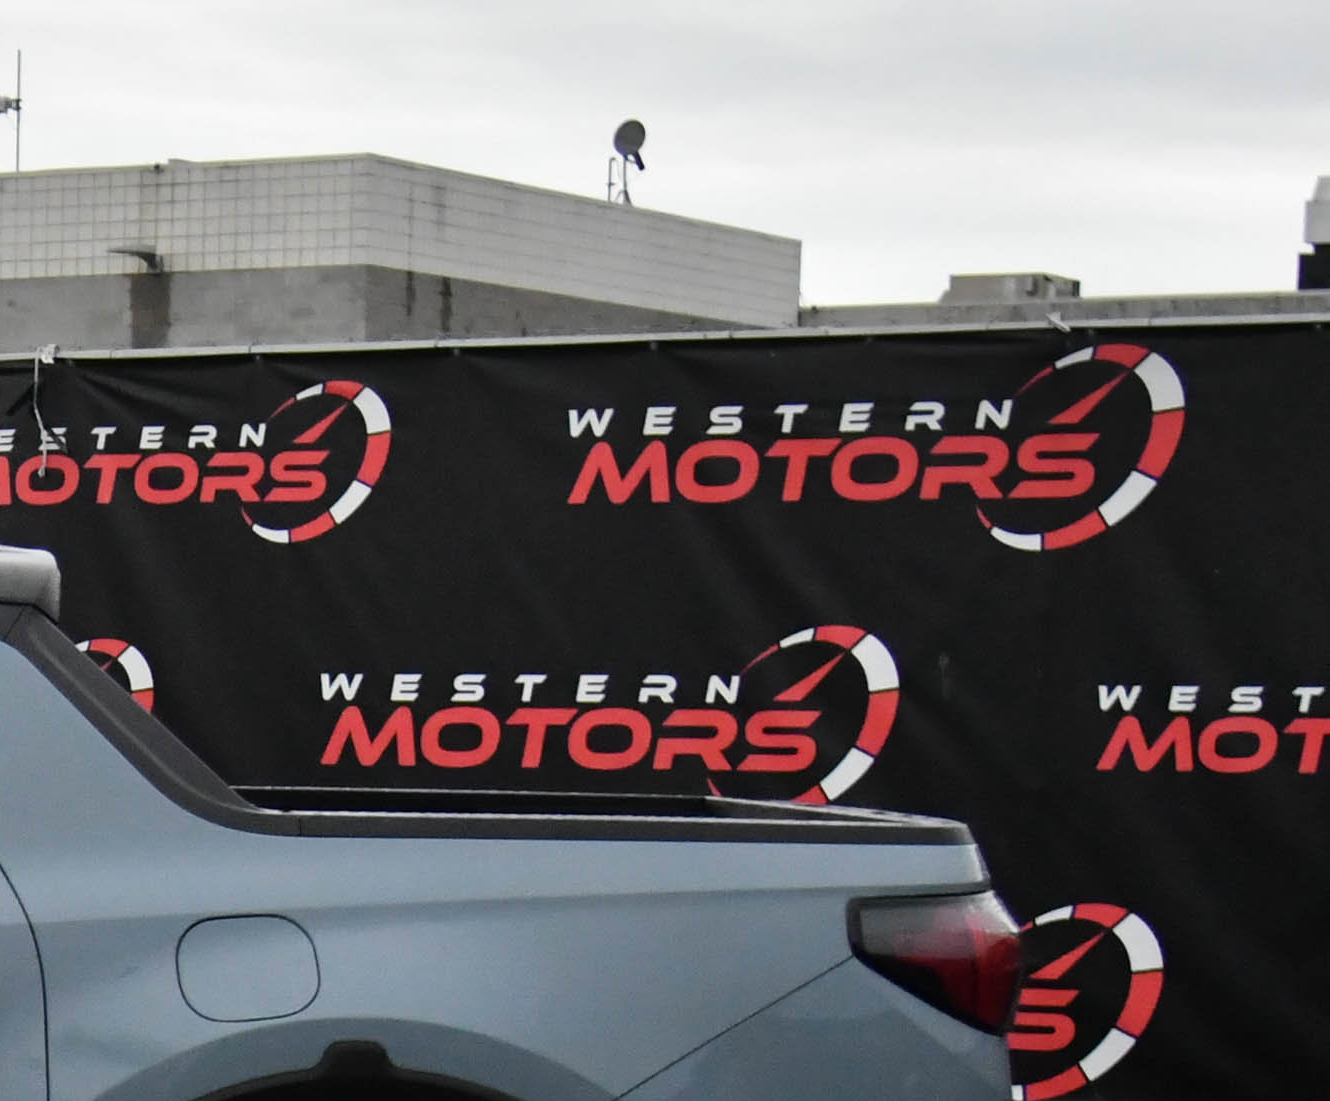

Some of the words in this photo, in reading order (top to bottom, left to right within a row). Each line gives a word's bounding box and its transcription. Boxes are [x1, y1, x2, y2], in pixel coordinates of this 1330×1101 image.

[568, 399, 1013, 438] WESTERN
[567, 432, 1100, 505] MOTORS
[320, 672, 741, 704] WESTERN
[1098, 684, 1325, 713] WEST
[320, 705, 824, 773] MOTORS
[1097, 714, 1330, 774] MOT
